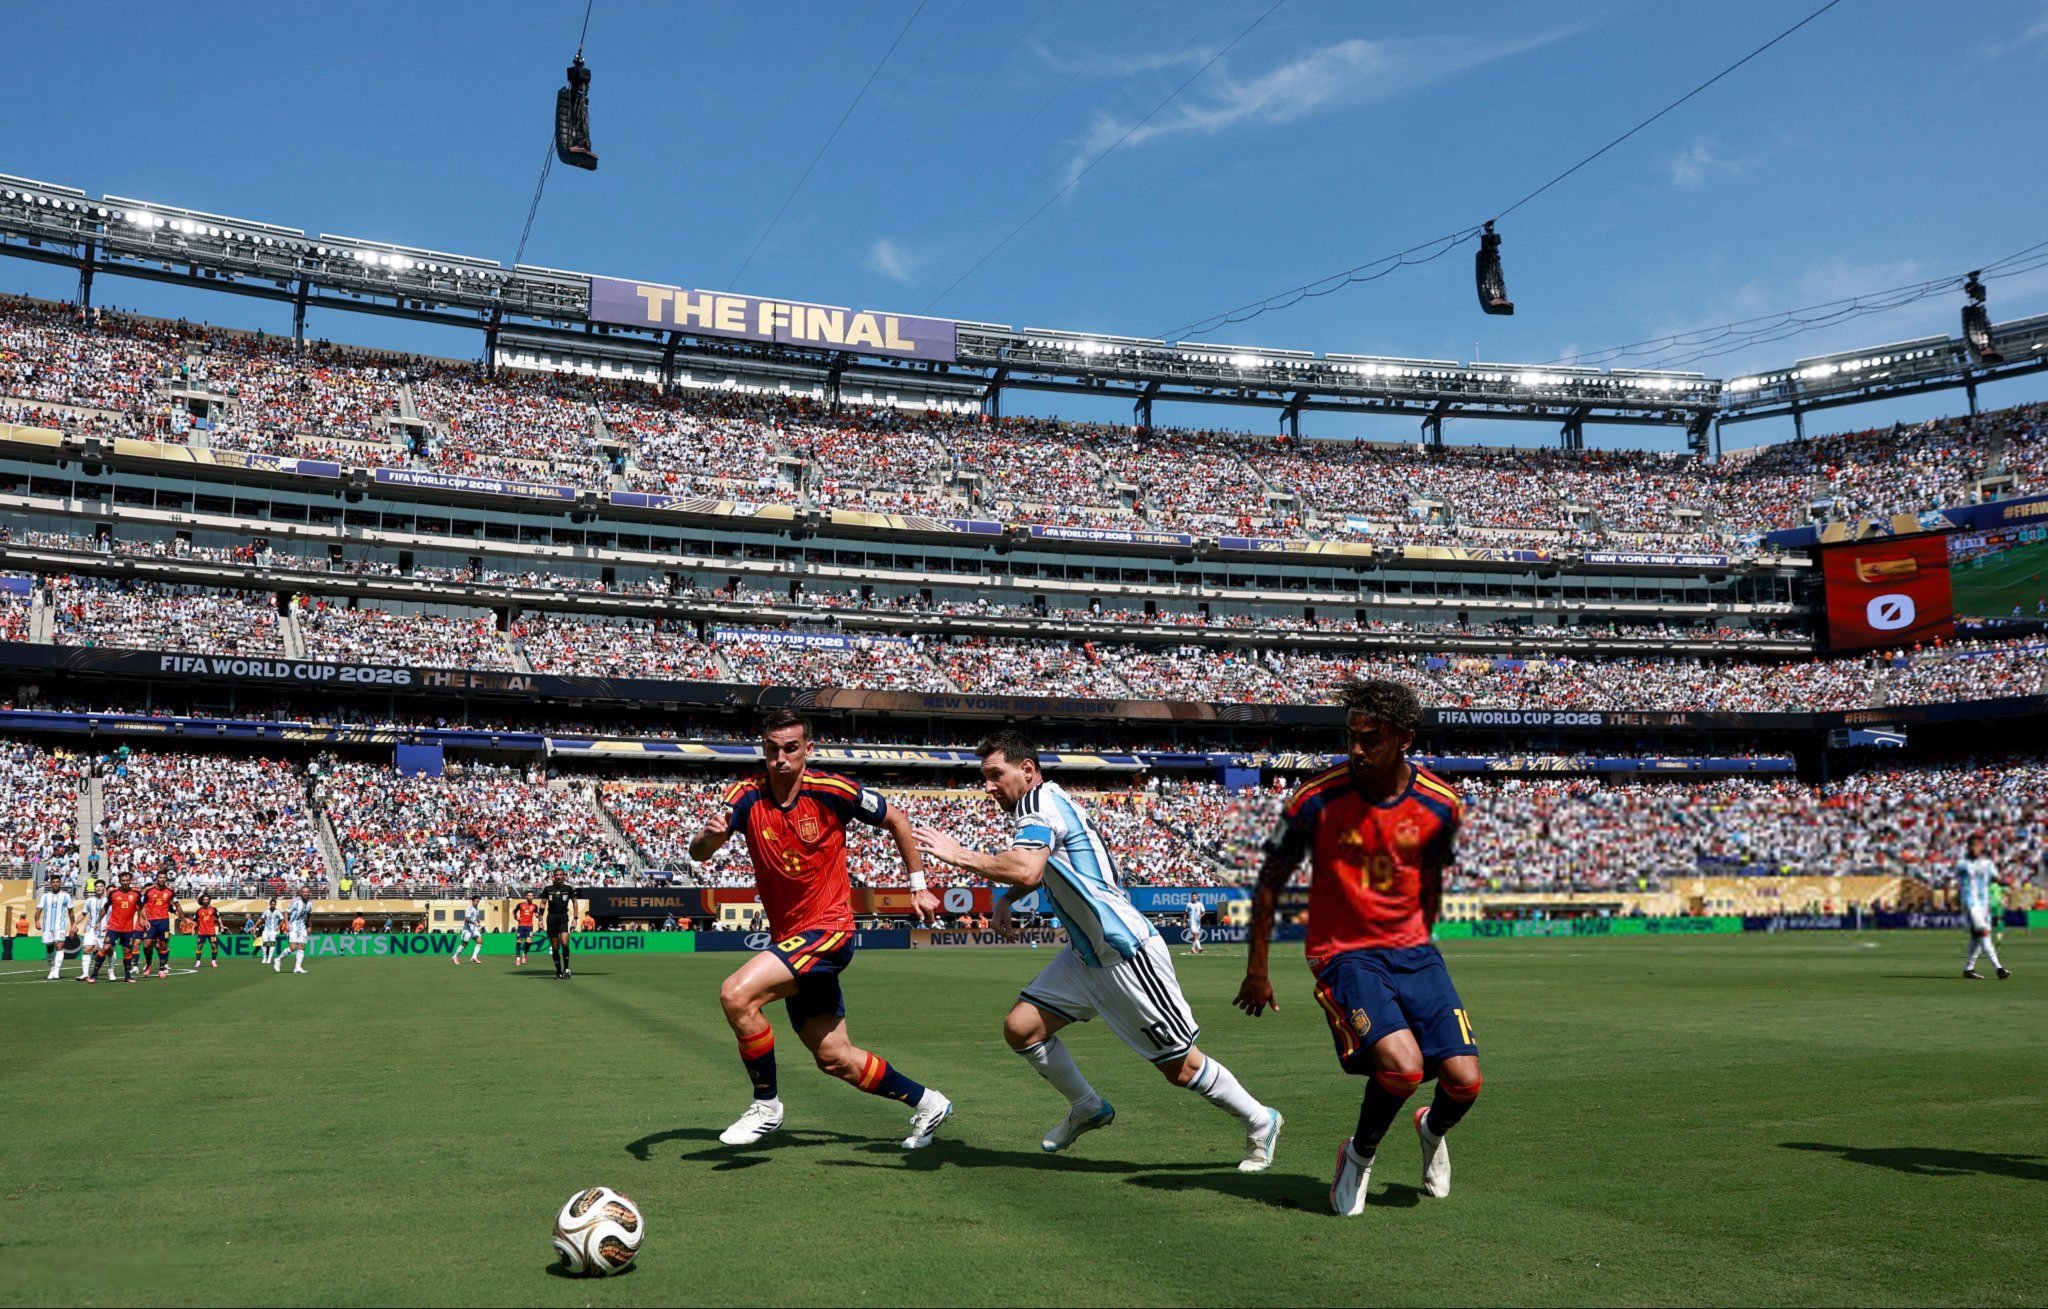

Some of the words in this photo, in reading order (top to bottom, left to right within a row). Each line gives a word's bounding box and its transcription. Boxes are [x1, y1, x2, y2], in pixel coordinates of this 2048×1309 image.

[637, 285, 747, 332] THE
[759, 302, 915, 351] FINAL
[389, 472, 411, 482] FIFA
[411, 474, 447, 486] WORLD
[448, 478, 466, 488] CUP
[468, 480, 502, 491] 2026
[505, 484, 528, 494] THE
[529, 487, 562, 497] FINAL
[1060, 529, 1088, 539] WORLD
[1088, 531, 1103, 539] CUP
[1104, 532, 1132, 541] 2026
[1154, 535, 1181, 543] FINAL
[1591, 554, 1616, 562] NEW
[1618, 555, 1649, 563] YORK
[1651, 556, 1676, 564] NEW
[1678, 557, 1721, 565] JERSEY
[716, 631, 741, 642] FIFA
[741, 632, 782, 644] WORLD
[783, 635, 805, 646] CUP
[805, 636, 844, 647] 2026
[161, 655, 208, 673] FIFA
[212, 658, 291, 678] WORLD
[294, 664, 336, 681] CUP
[339, 666, 411, 685] 2026
[419, 670, 466, 687] THE
[470, 673, 539, 691] FINAL
[923, 697, 960, 709] NEW
[964, 698, 1009, 710] YORK
[1014, 699, 1051, 711] NEW
[1056, 701, 1117, 713] JERSEY
[1438, 711, 1468, 724] FIFA
[1470, 711, 1522, 725] WORLD
[1523, 712, 1551, 725] CUP
[1553, 712, 1602, 725] 2026
[1608, 713, 1640, 725] THE
[811, 748, 848, 759] HE
[851, 750, 940, 761] FINAL
[608, 896, 638, 907] THE
[640, 897, 685, 908] FINAL
[1471, 921, 1514, 937] NEXT
[216, 936, 291, 956] NET
[306, 935, 388, 955] TARTS
[390, 935, 458, 954] NOW
[571, 935, 645, 949] YUNDAI
[777, 936, 806, 952] 8
[931, 932, 968, 945] NEW
[1020, 932, 1055, 944] NEW
[1140, 1021, 1177, 1050] 10
